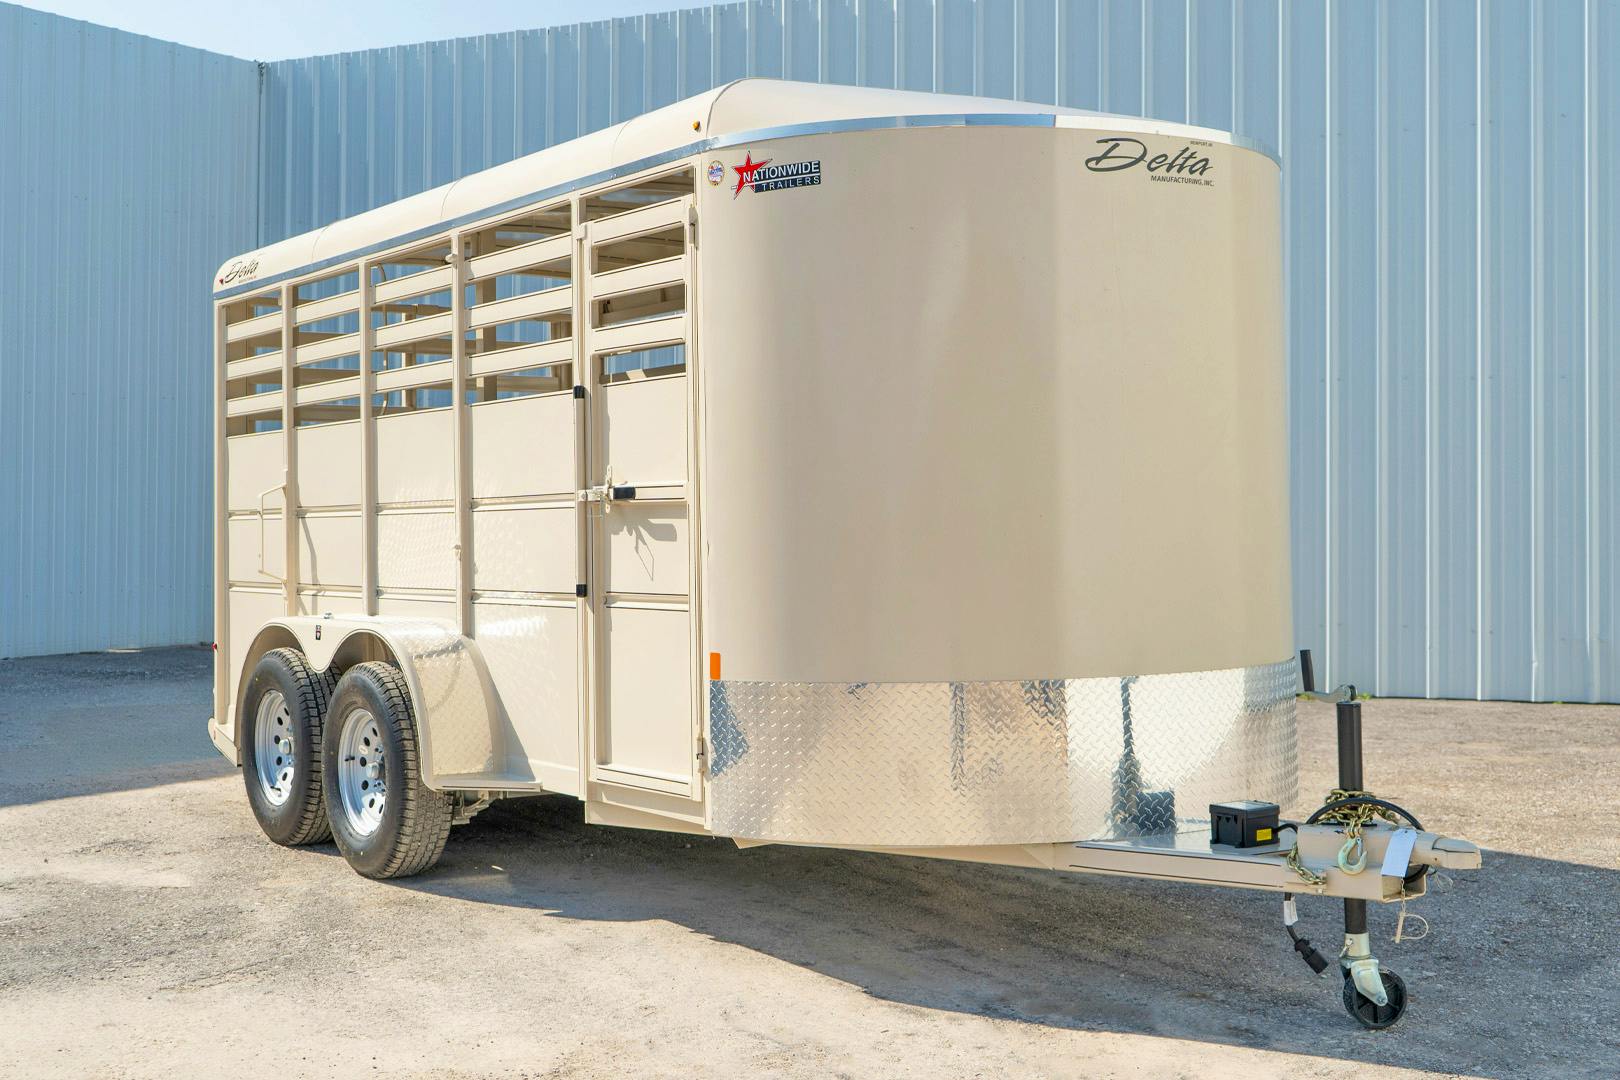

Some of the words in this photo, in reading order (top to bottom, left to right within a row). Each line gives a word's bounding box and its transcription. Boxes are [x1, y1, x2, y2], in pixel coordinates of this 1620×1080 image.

[1084, 137, 1213, 176] Delta
[743, 161, 820, 182] NATIONWIDE
[761, 175, 820, 190] TRAILERS
[1150, 175, 1203, 186] MANUFACTURING,
[1203, 179, 1215, 187] INC.
